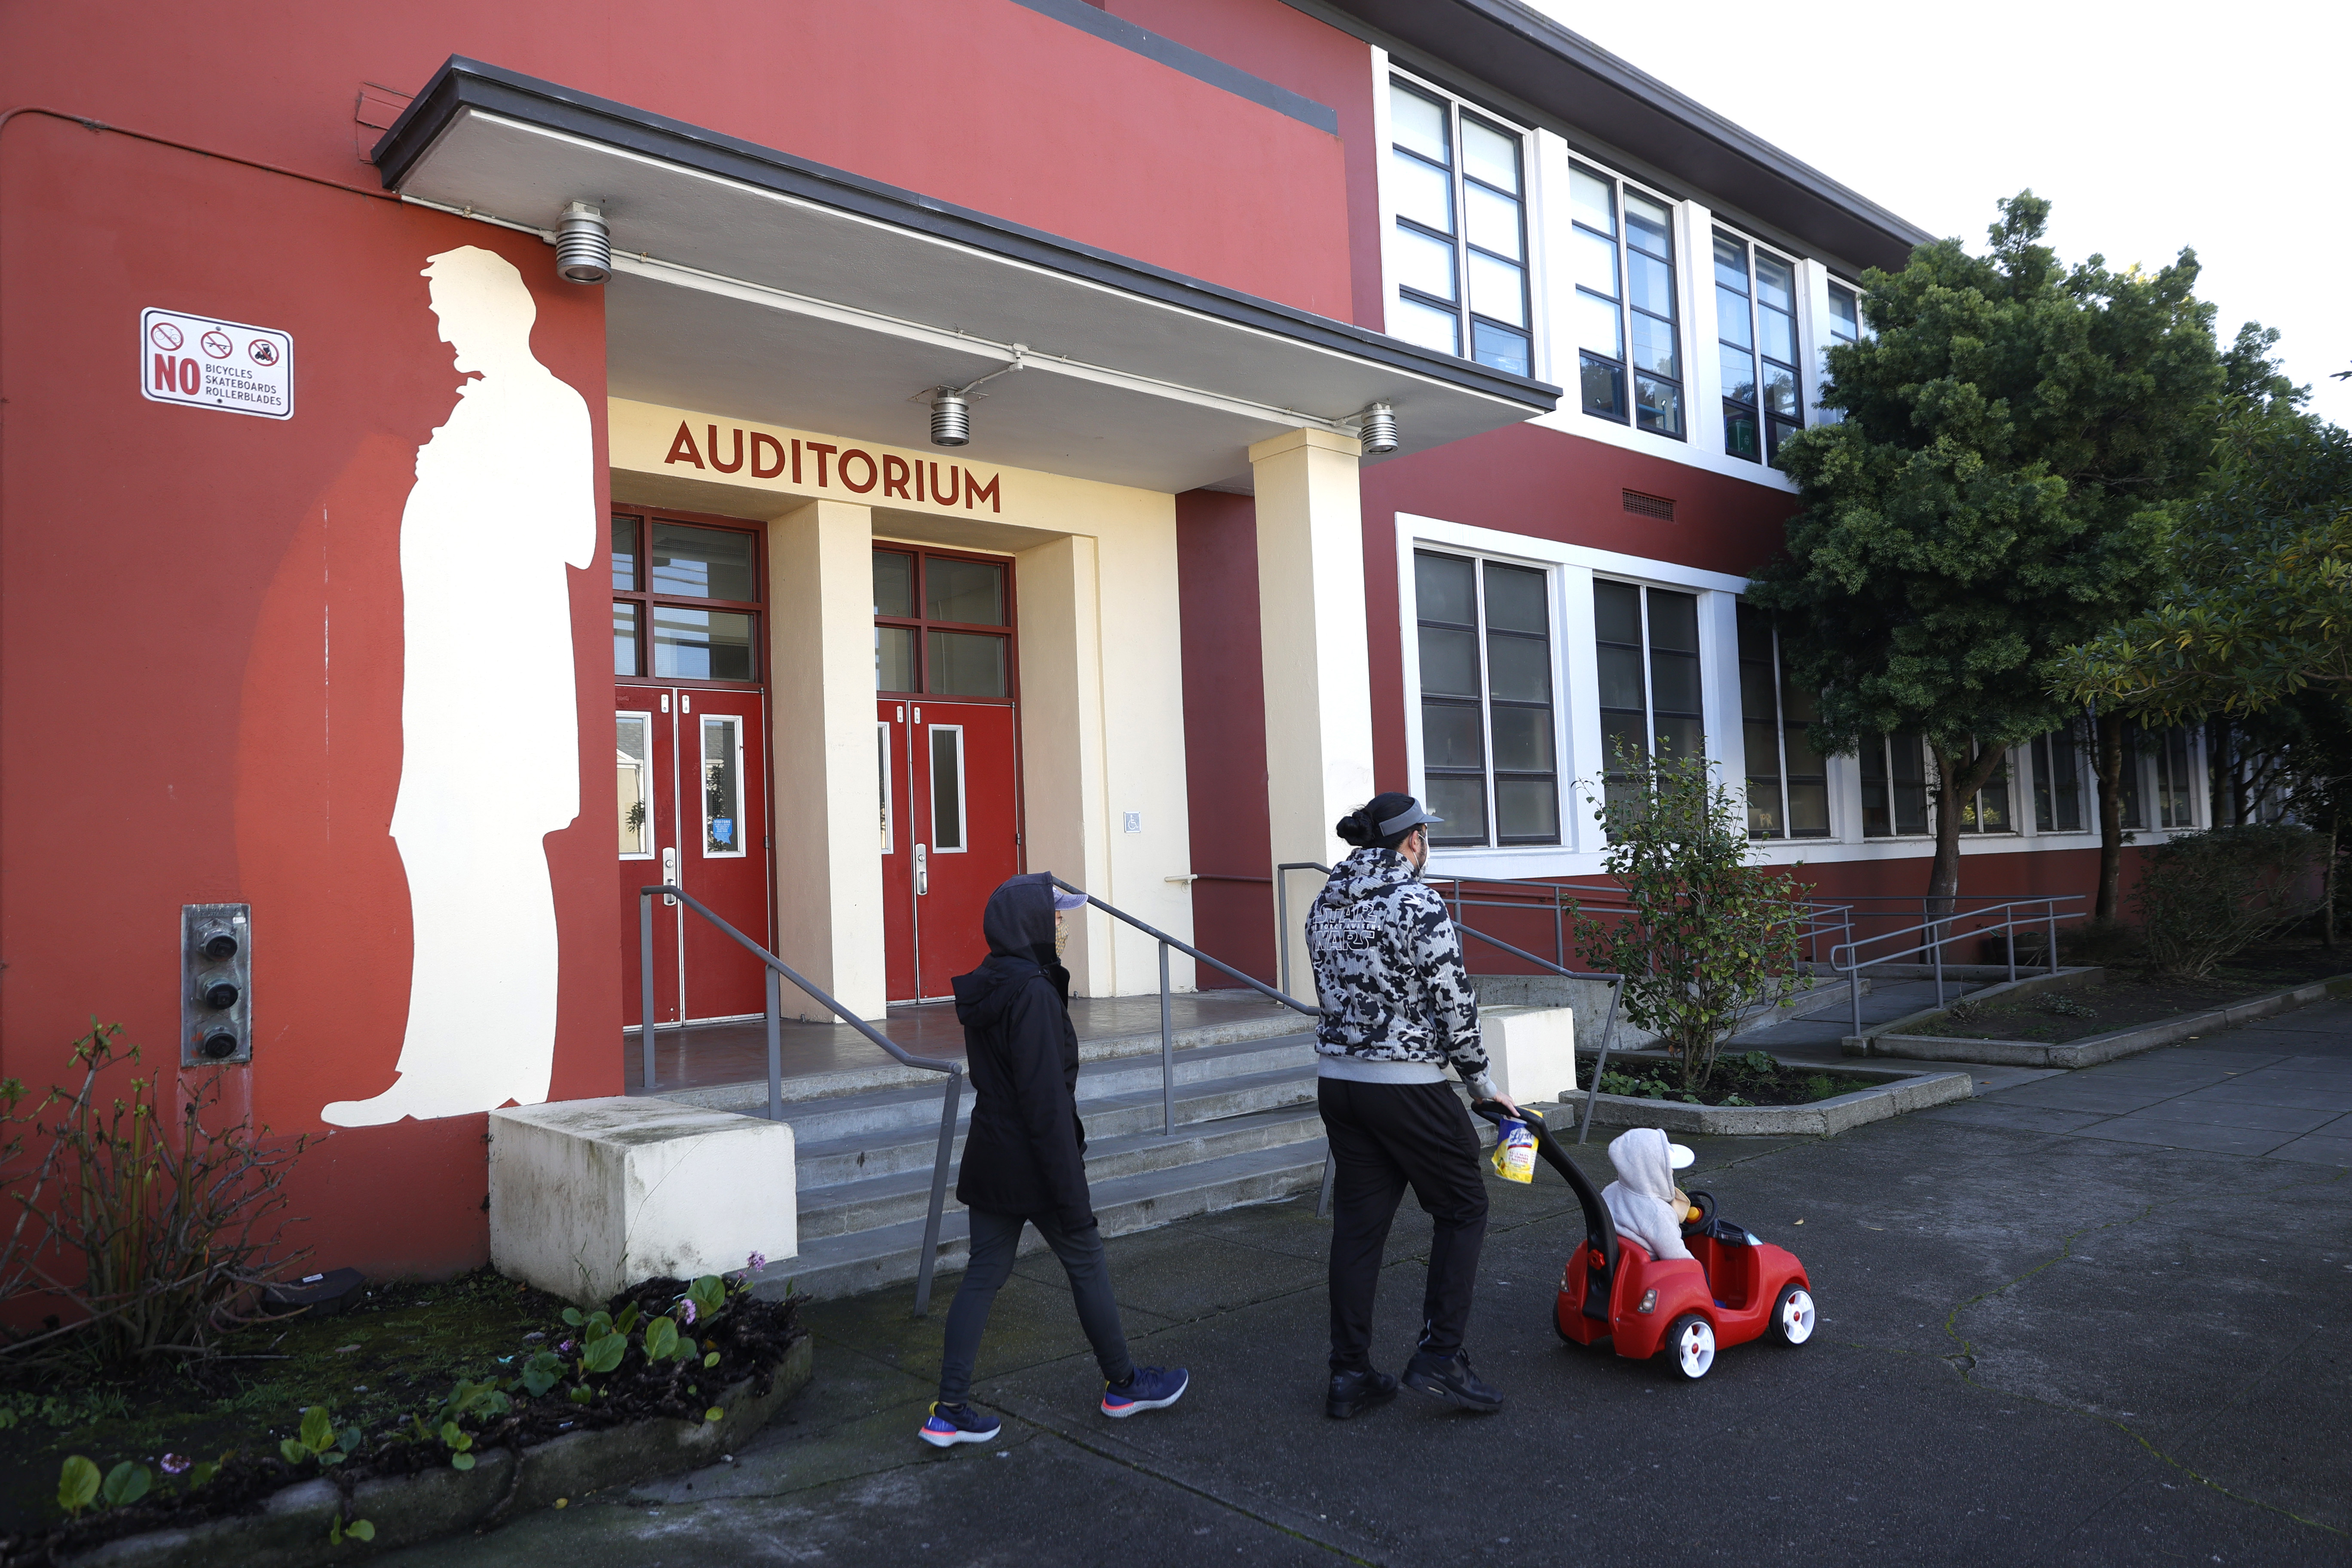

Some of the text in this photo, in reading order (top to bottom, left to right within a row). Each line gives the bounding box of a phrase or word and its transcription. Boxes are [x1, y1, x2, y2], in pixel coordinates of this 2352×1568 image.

[155, 353, 201, 395] NO
[205, 363, 253, 379] BICYCLES
[205, 375, 277, 394] SKATEBOARDS
[205, 386, 282, 406] ROLLERBLADES
[664, 419, 1001, 514] AUDITORIUM
[1313, 902, 1377, 924] STAR
[1313, 930, 1375, 951] WARS
